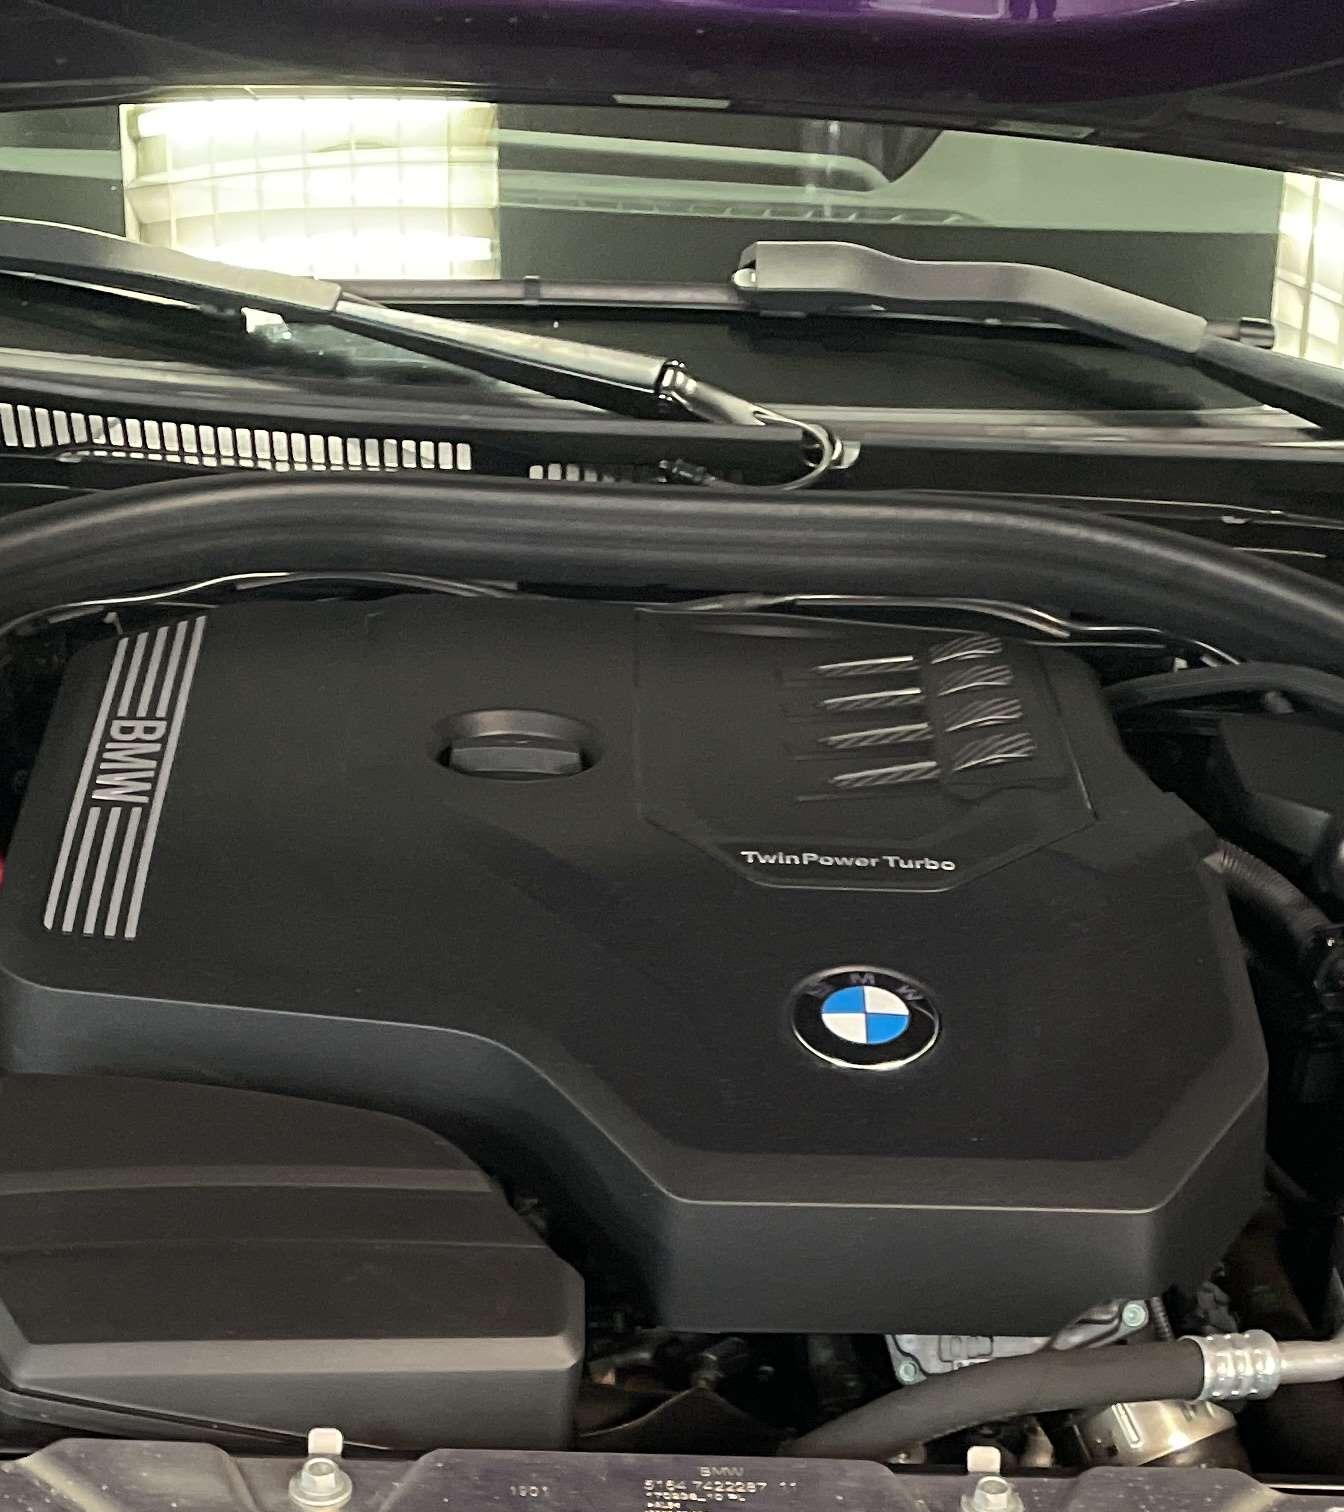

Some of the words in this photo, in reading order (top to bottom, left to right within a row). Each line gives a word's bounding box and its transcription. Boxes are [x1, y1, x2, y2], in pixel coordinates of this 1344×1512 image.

[92, 720, 168, 803] BMW
[882, 856, 955, 871] Turbo
[700, 1466, 744, 1477] BMW
